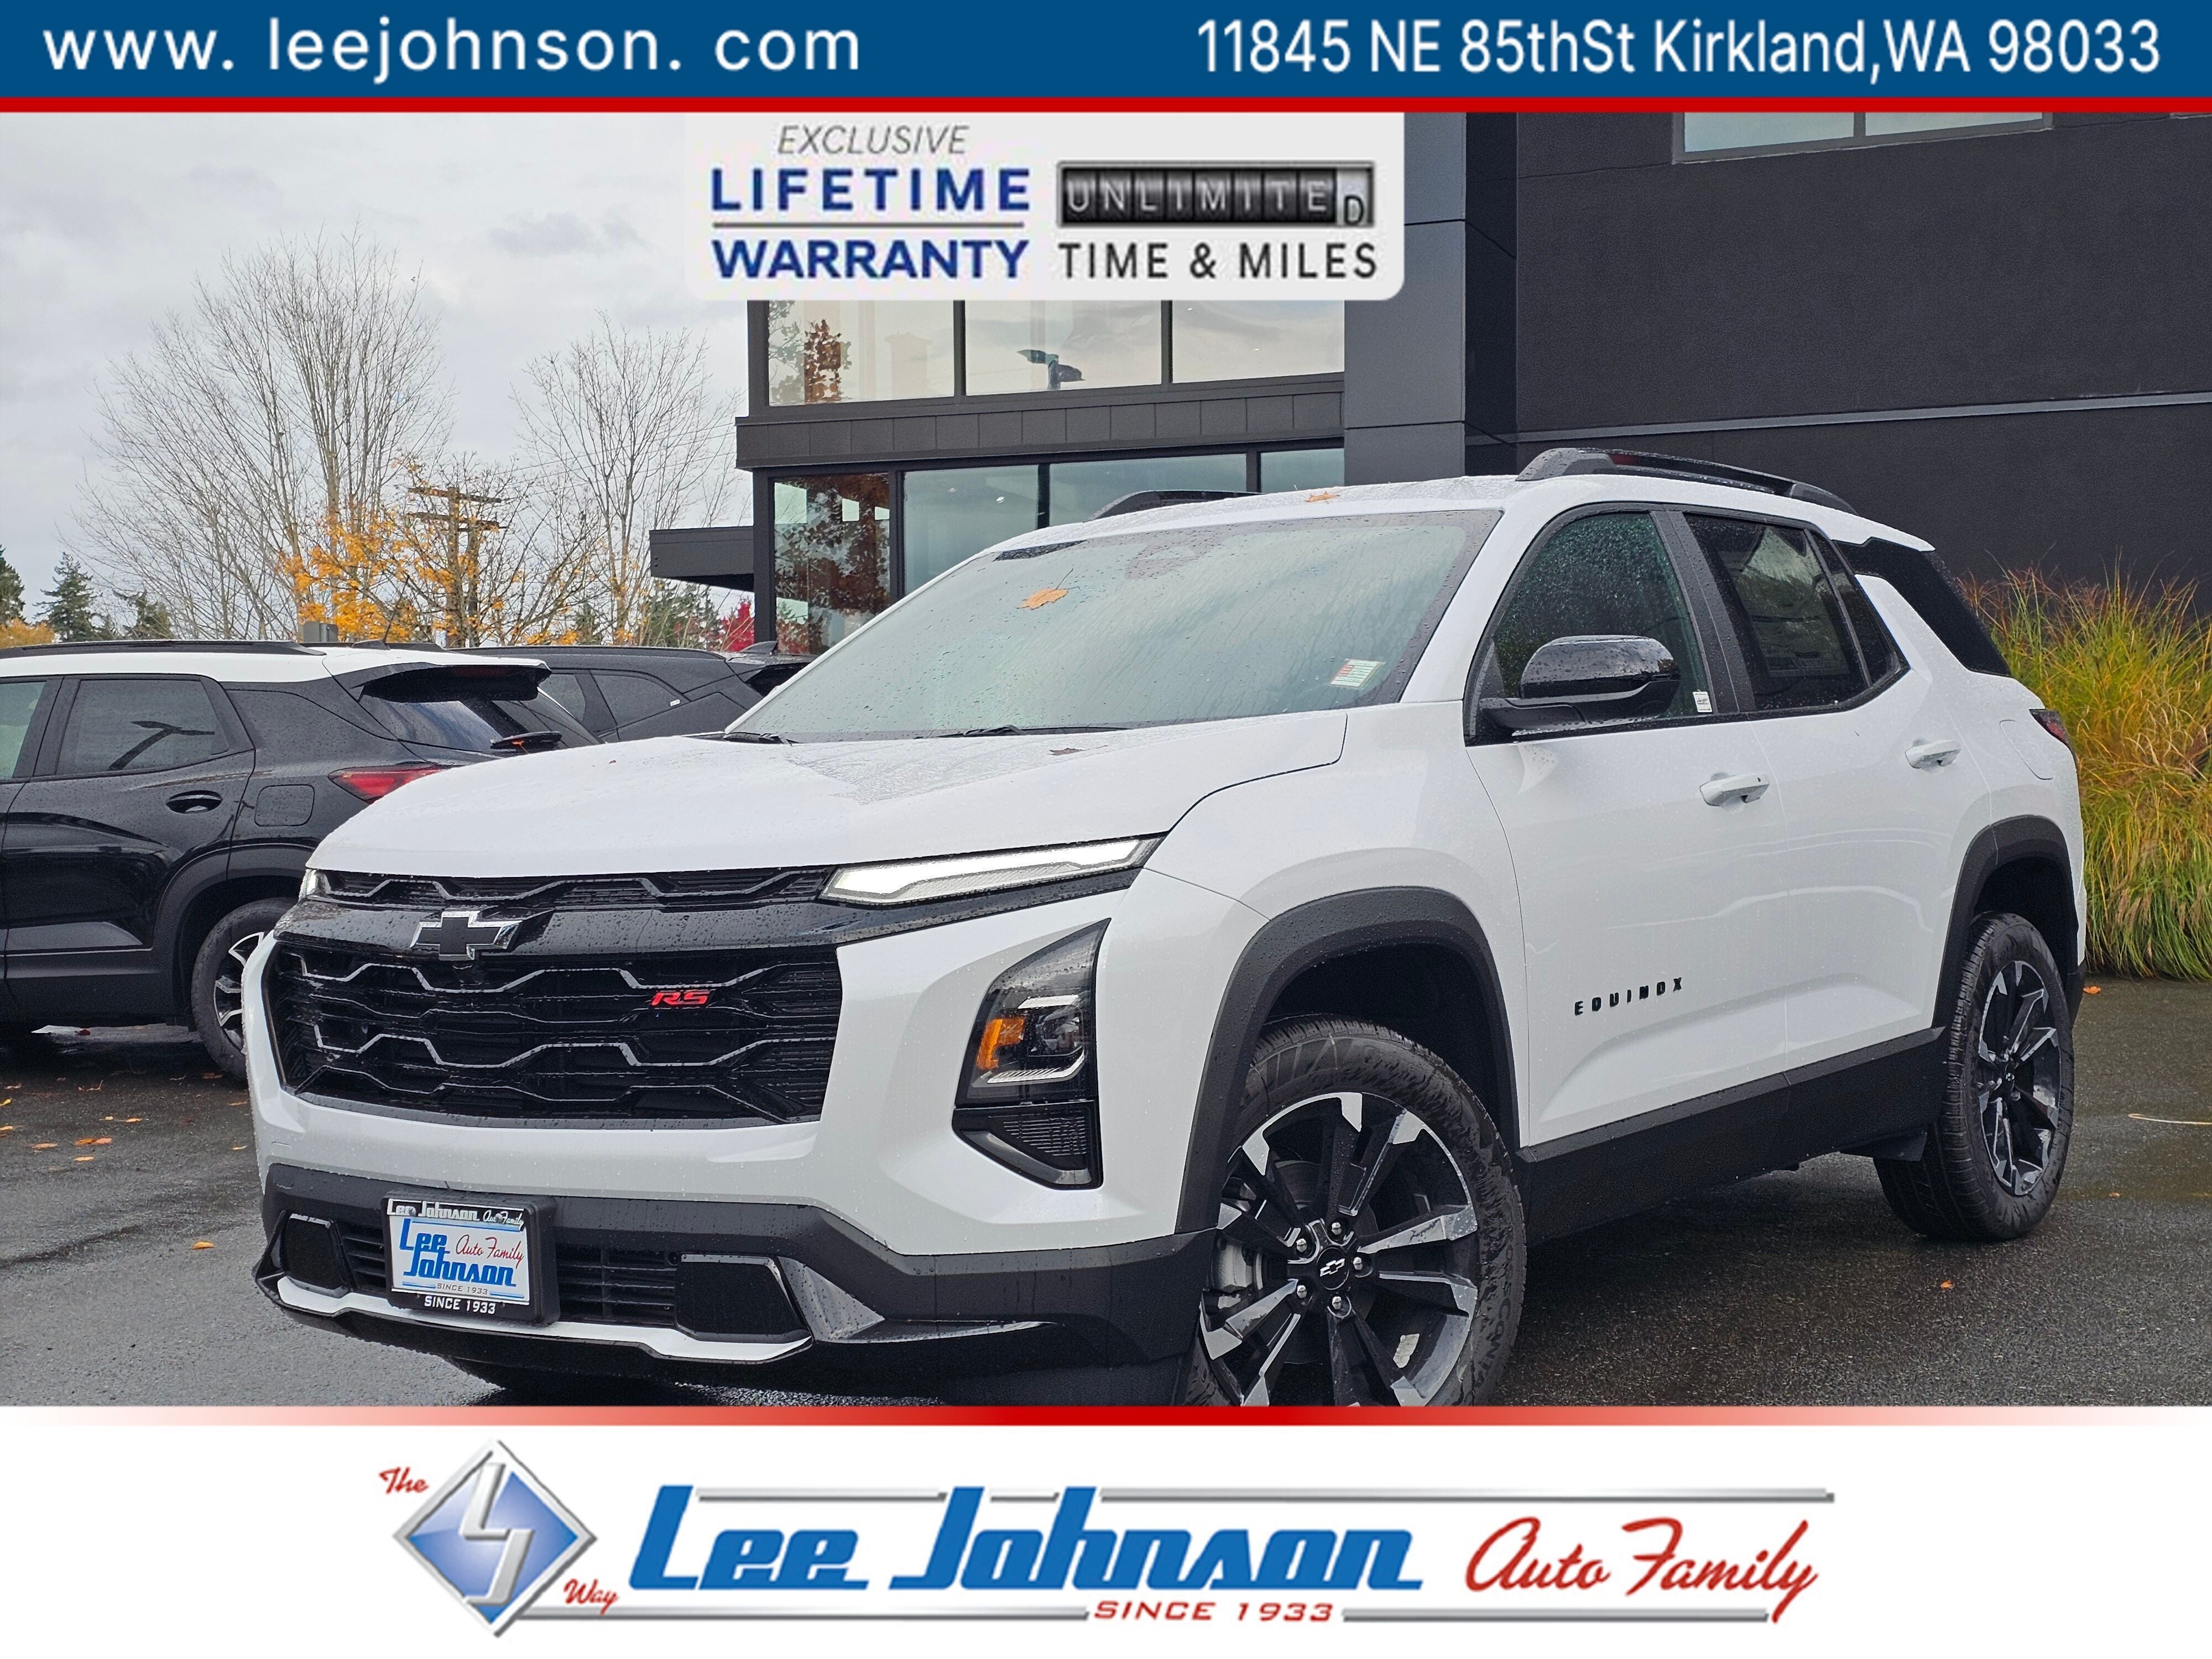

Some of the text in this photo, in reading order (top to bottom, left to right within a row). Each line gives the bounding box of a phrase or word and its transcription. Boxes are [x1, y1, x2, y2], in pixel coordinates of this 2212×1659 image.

[650, 989, 711, 1006] RS
[1574, 977, 1682, 1016] EQUINOX
[418, 1201, 480, 1222] Johnson
[500, 1211, 524, 1231] Family
[399, 1218, 524, 1269] Lee Auto Family
[403, 1249, 517, 1287] Johnson
[436, 1283, 488, 1295] SINCE 1933
[424, 1296, 495, 1314] SINCE 1933
